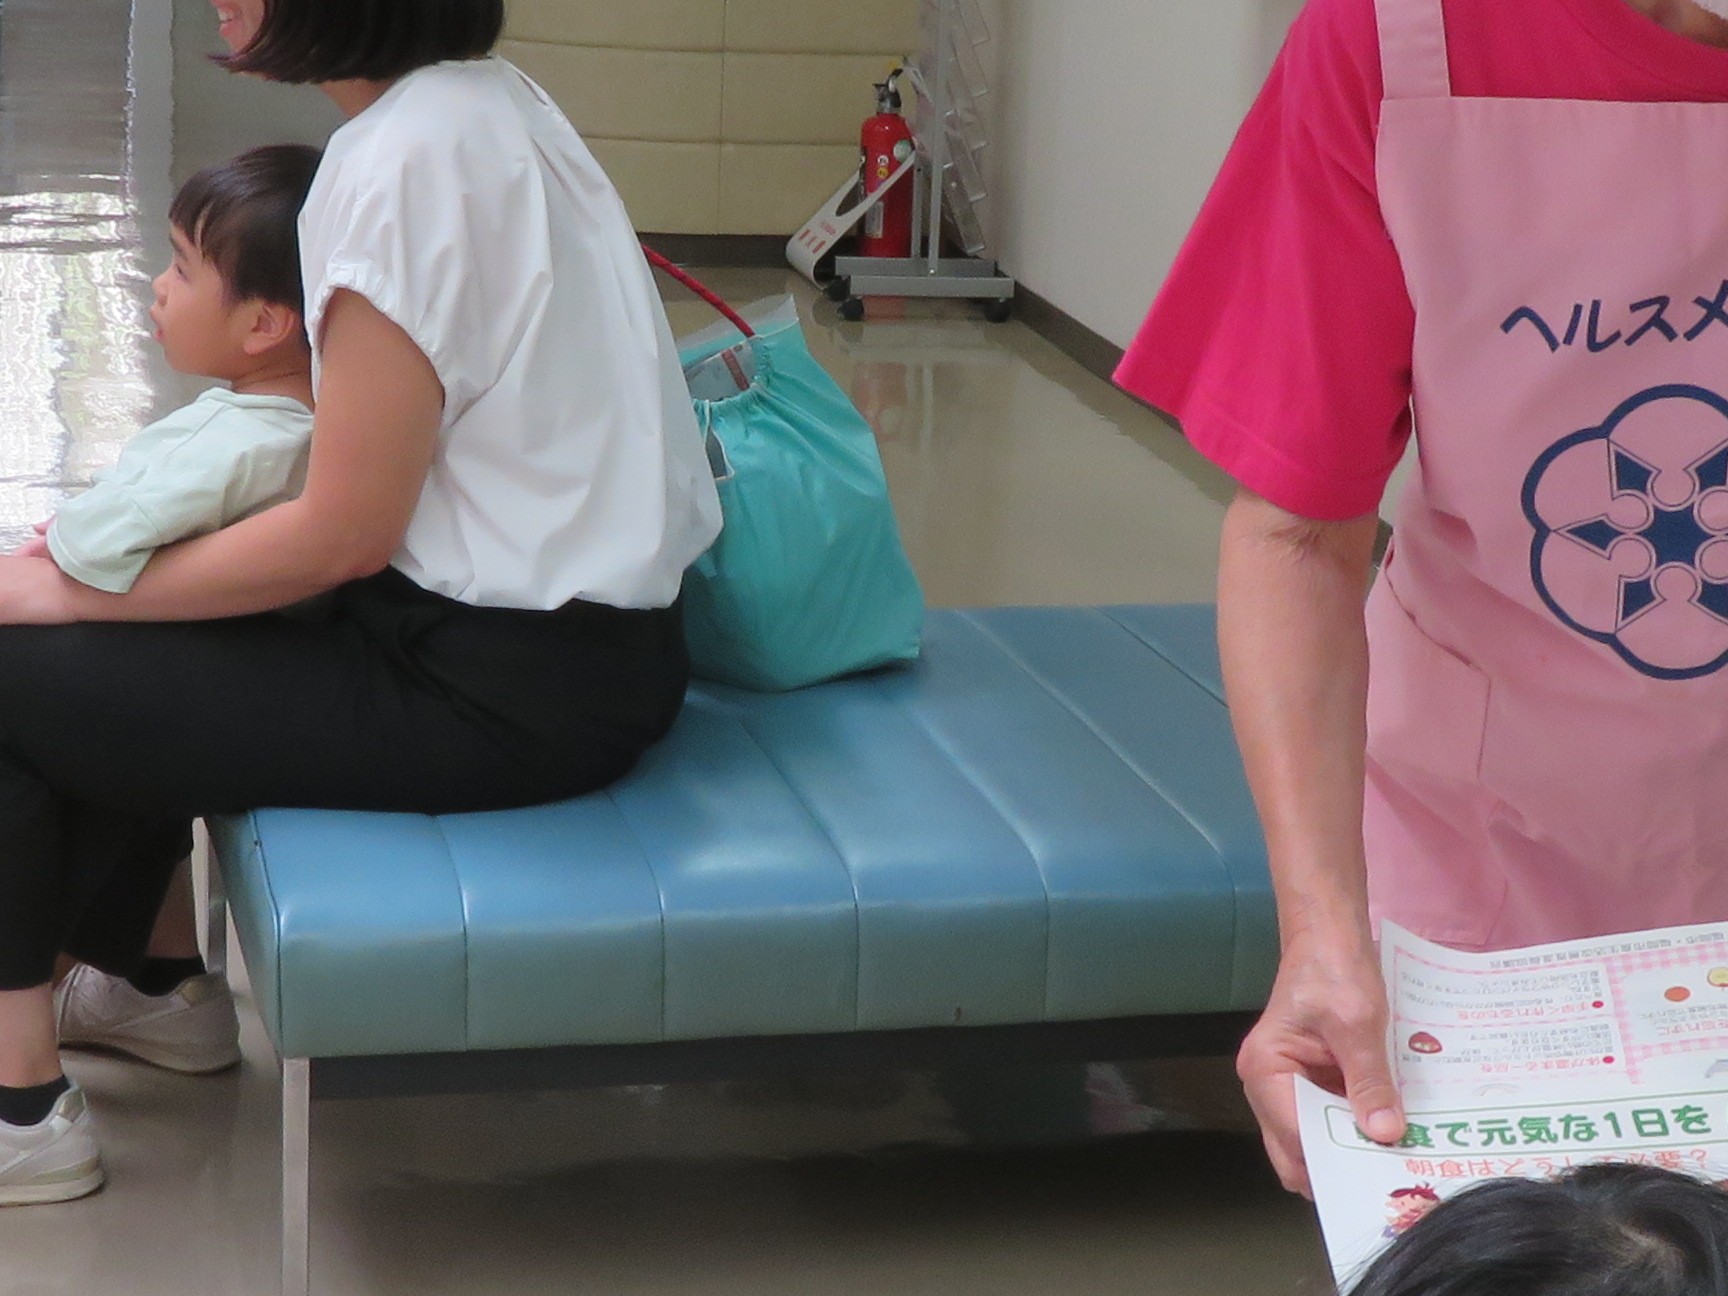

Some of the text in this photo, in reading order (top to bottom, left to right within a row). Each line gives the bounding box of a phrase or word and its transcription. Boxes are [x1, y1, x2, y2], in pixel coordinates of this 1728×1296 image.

[1479, 1055, 1601, 1074] 体が温まる一品を
